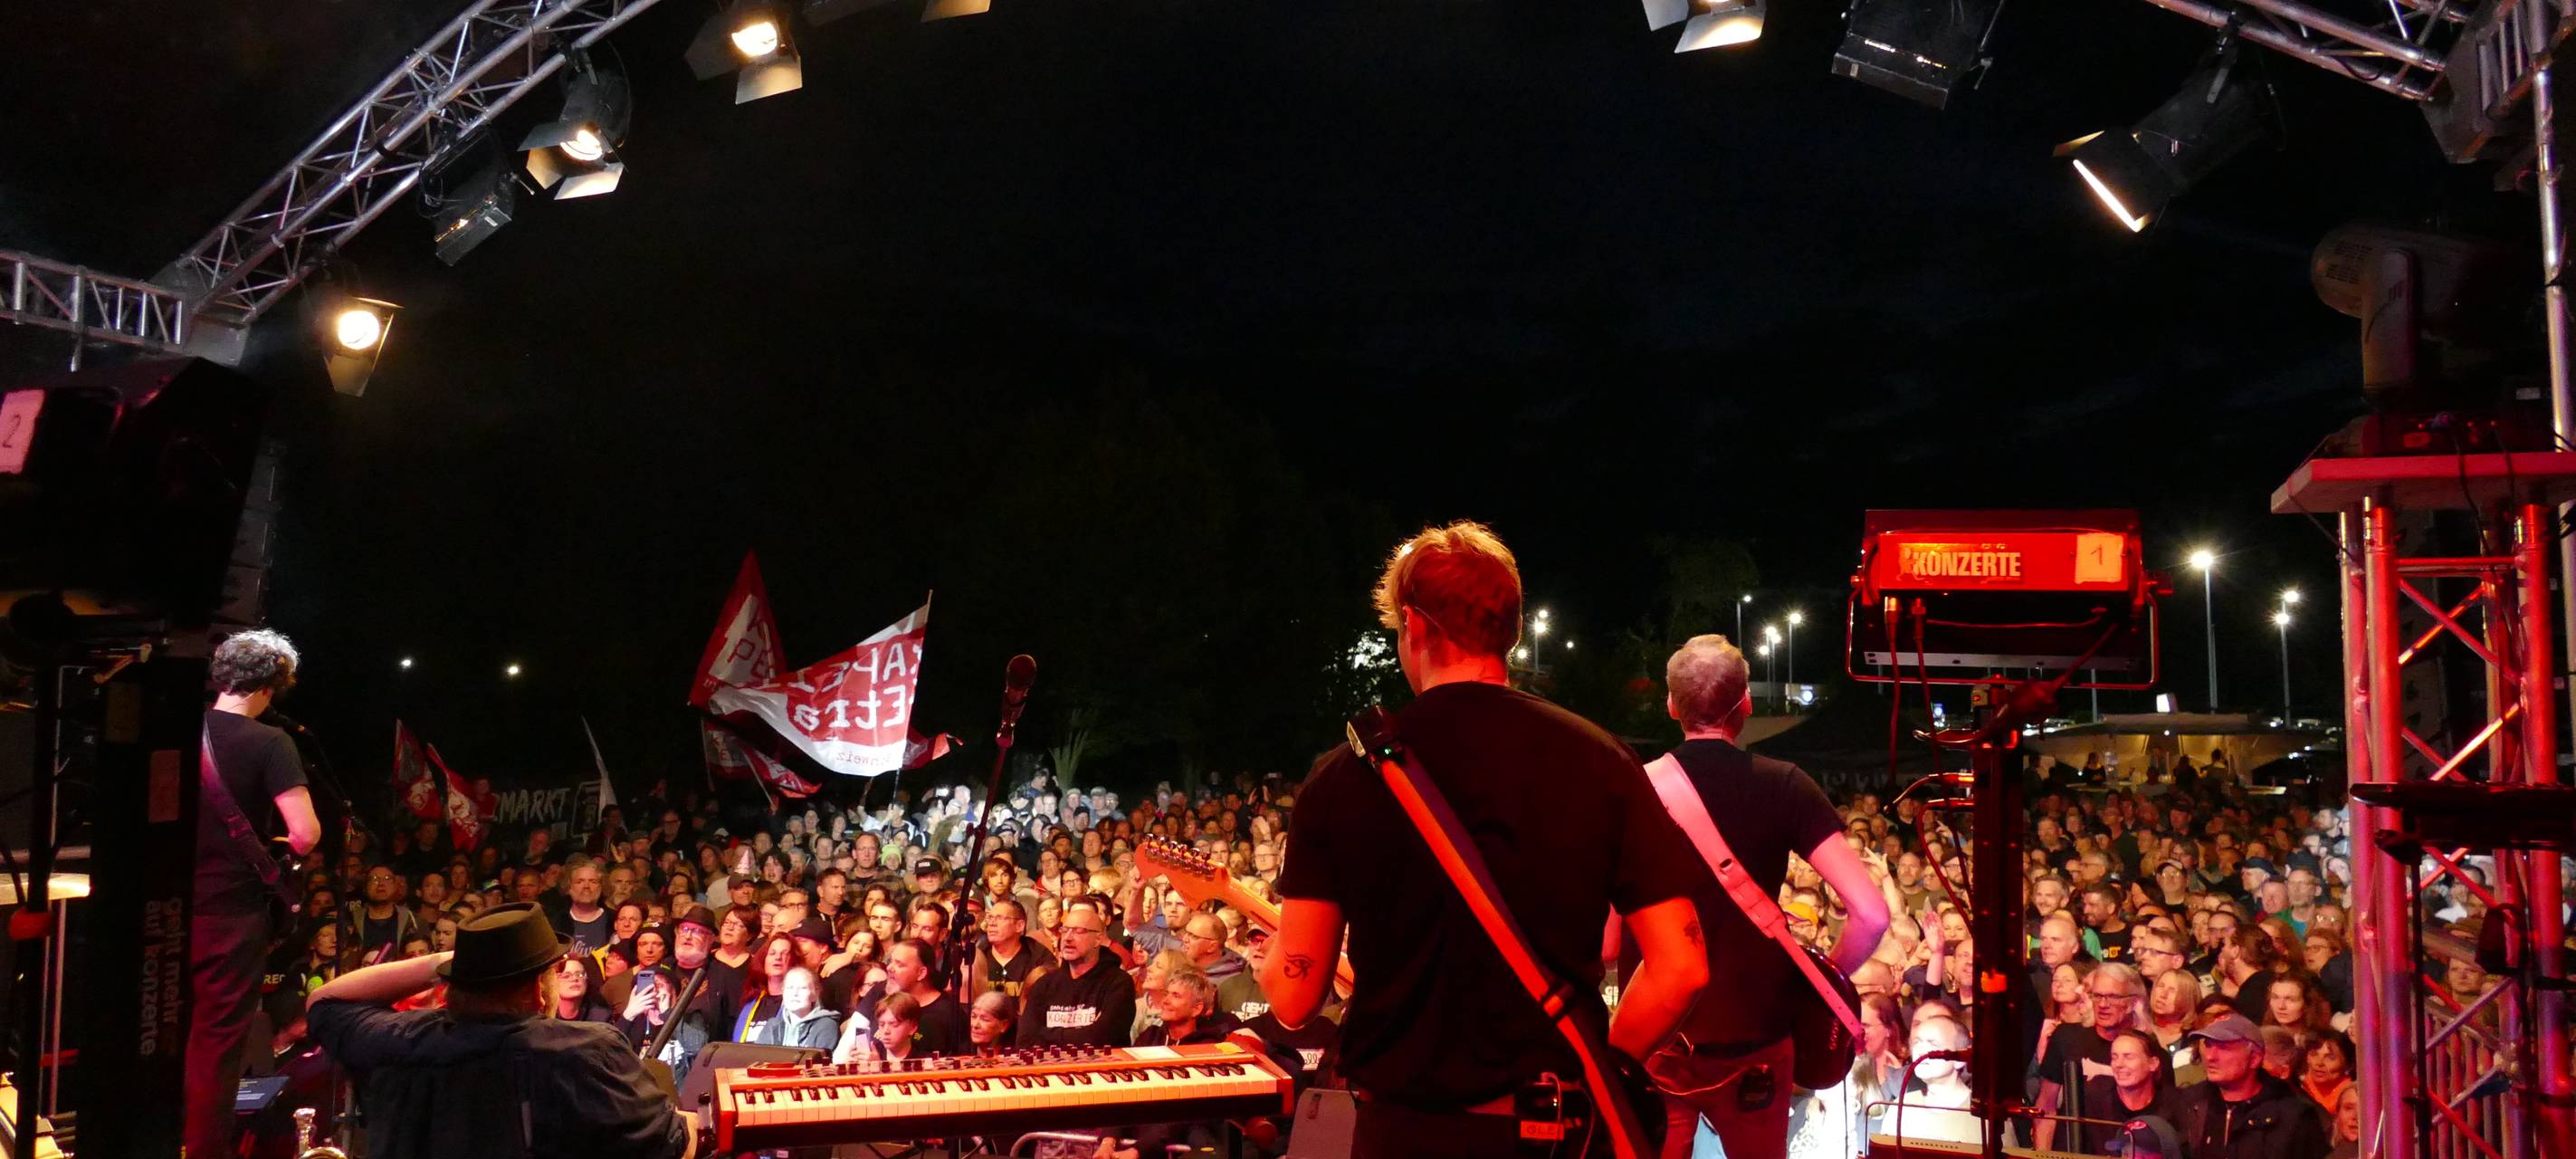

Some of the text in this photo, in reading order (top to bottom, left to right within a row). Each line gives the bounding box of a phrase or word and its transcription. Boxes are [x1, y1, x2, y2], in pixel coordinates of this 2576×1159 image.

[2, 414, 22, 448] 2
[1912, 551, 2021, 577] KONZERTE
[2089, 543, 2104, 566] 1
[160, 895, 184, 1026] geht mehr
[138, 900, 163, 1058] auf konzerte
